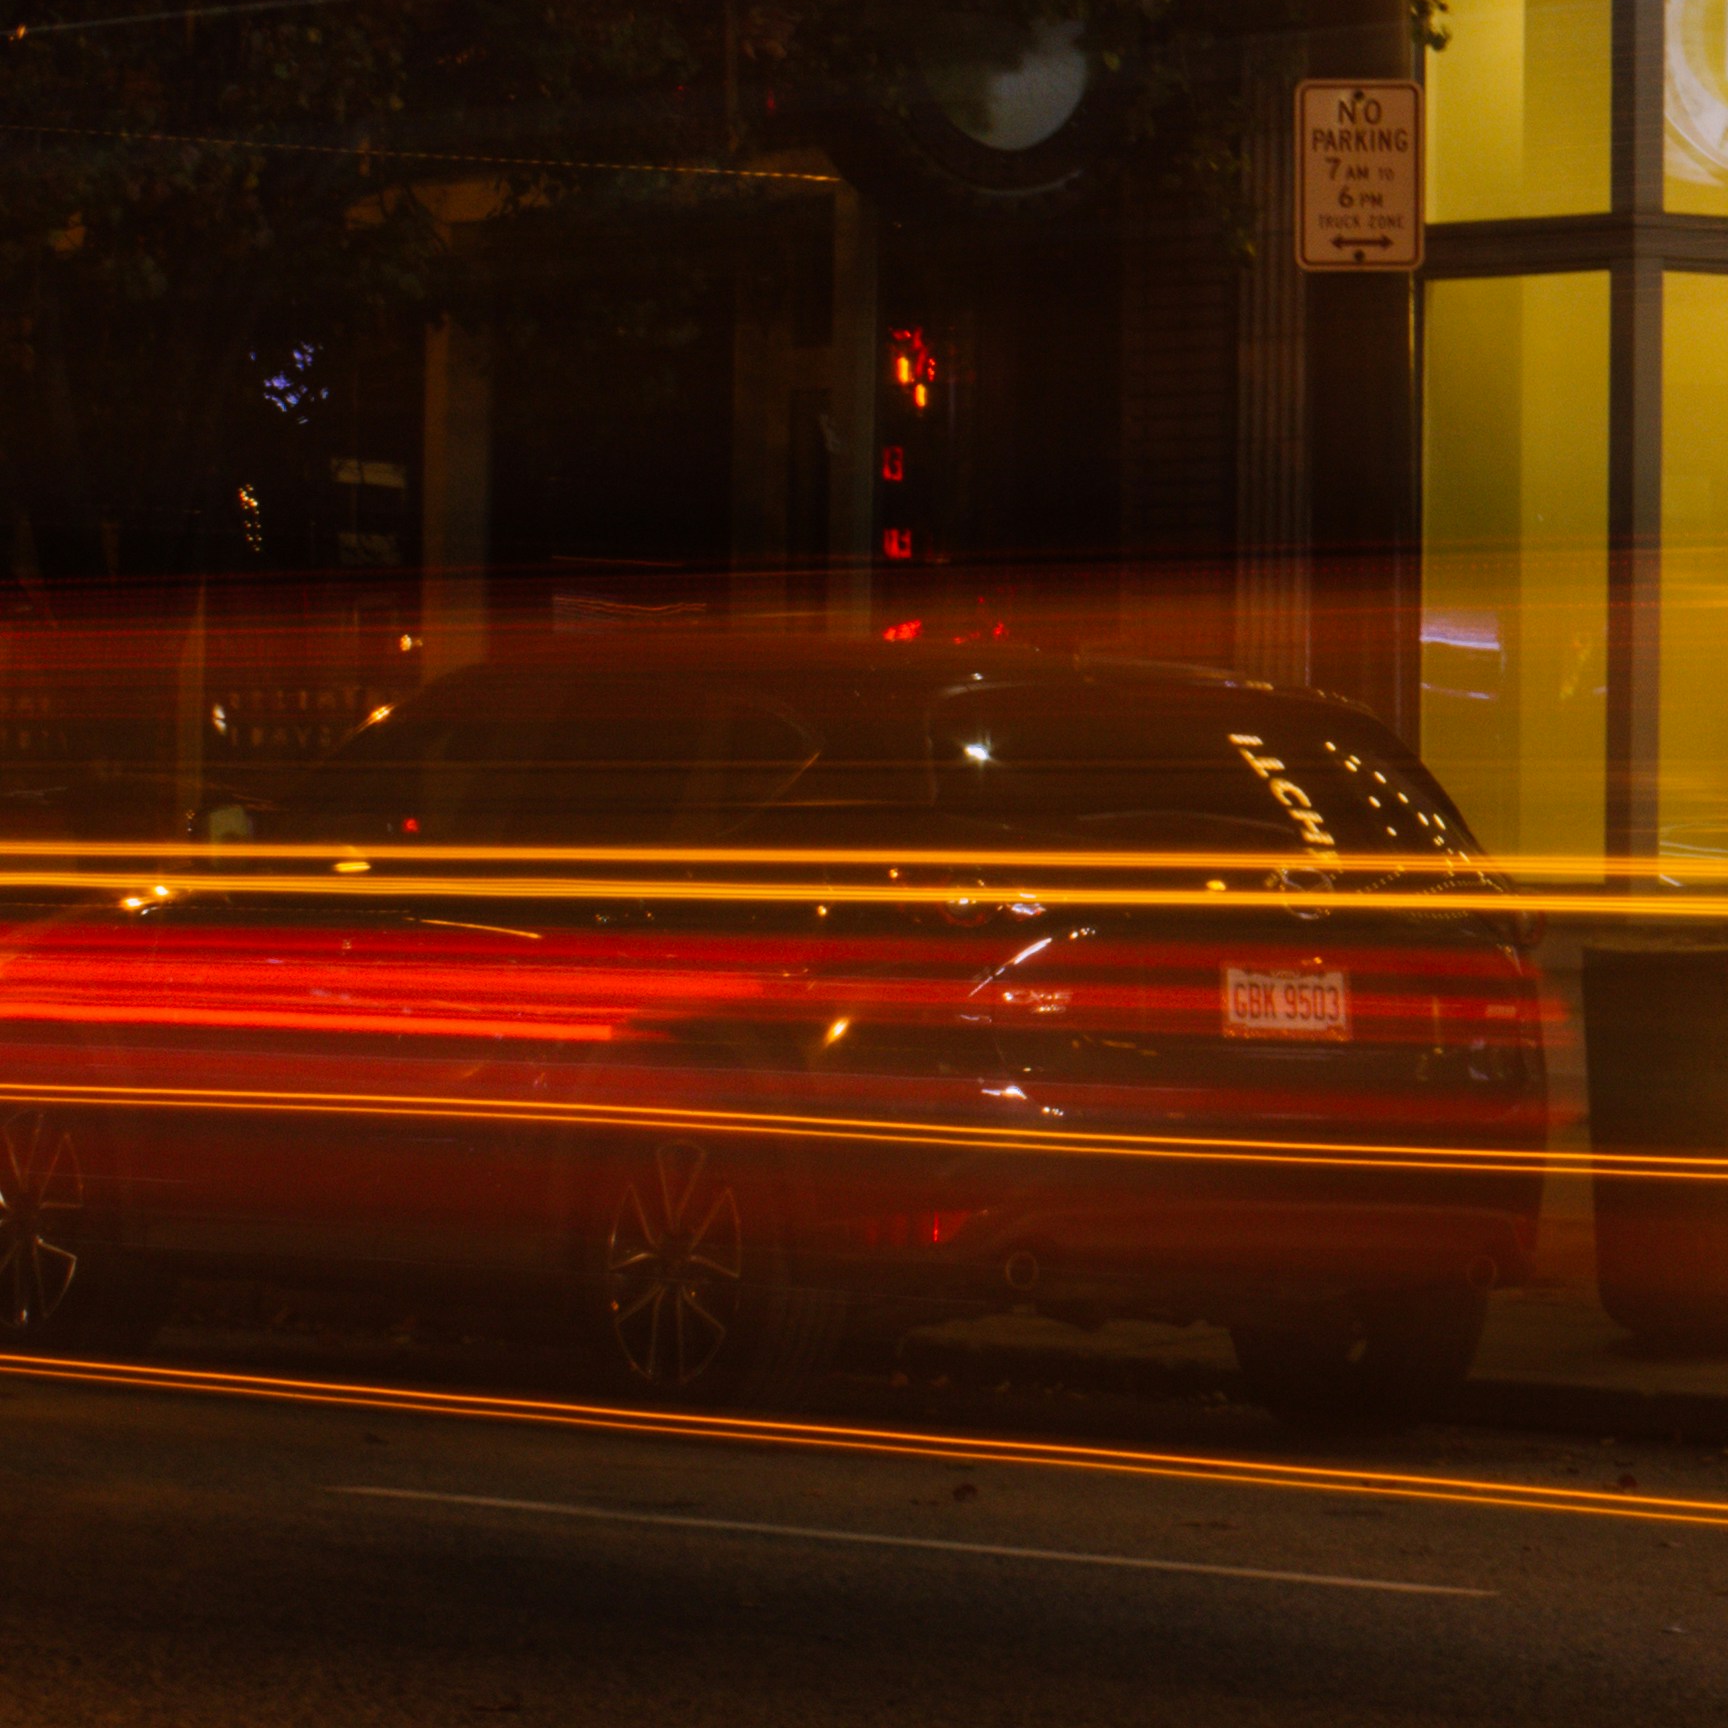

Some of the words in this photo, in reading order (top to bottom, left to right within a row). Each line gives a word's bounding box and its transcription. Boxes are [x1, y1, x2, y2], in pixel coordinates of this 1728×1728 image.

[1338, 99, 1382, 124] NO
[1312, 129, 1409, 153] PARKING
[1325, 157, 1342, 181] 7
[1346, 165, 1369, 181] AM
[1377, 167, 1395, 181] TO
[1338, 185, 1354, 209] 6
[1359, 192, 1384, 208] PM
[1318, 214, 1361, 230] TRUCK
[1369, 214, 1406, 231] ZONE
[1234, 983, 1277, 1019] GBK
[1285, 983, 1340, 1020] 9503
